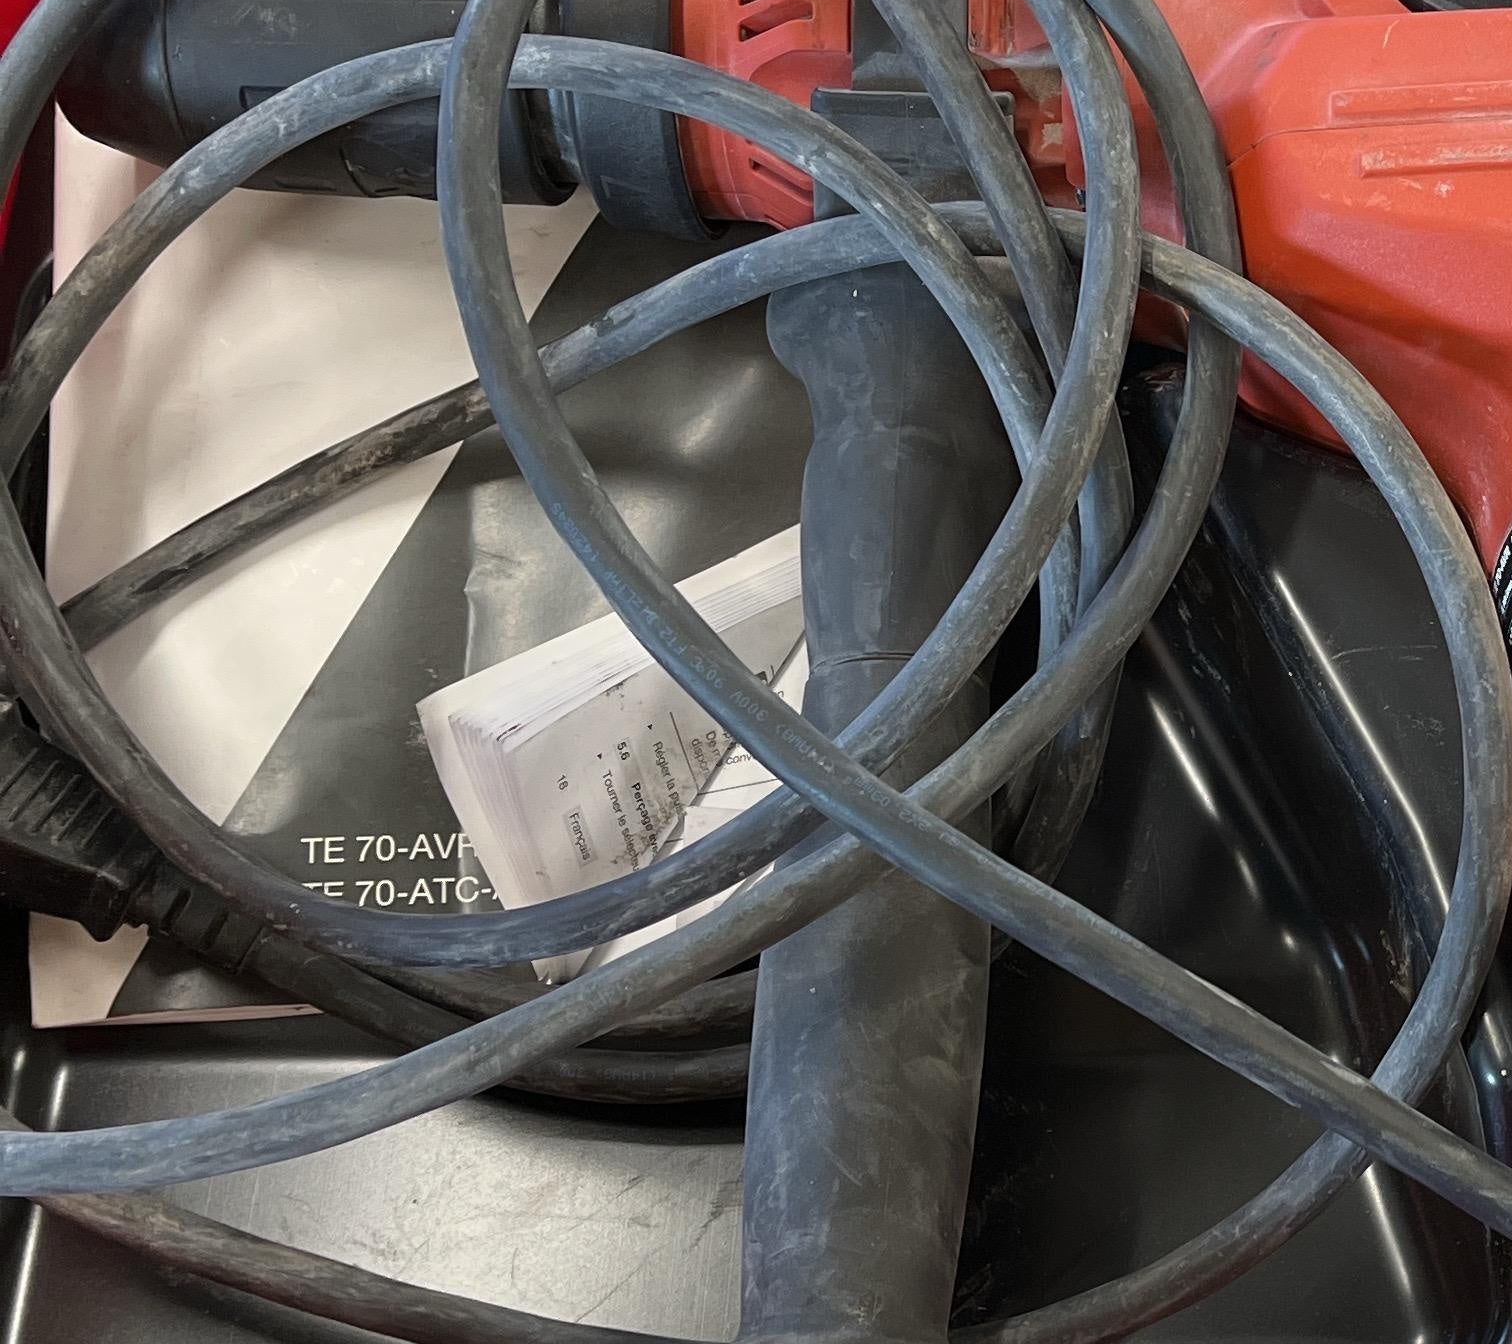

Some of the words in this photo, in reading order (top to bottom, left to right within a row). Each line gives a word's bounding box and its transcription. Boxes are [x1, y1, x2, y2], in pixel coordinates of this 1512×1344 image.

[616, 740, 631, 761] 5.6
[630, 782, 655, 832] Perçage
[652, 740, 673, 777] Régler
[665, 779, 677, 791] la
[555, 773, 569, 792] 18
[568, 811, 592, 862] Français
[601, 768, 624, 814] Tourner
[616, 814, 627, 827] le
[300, 836, 346, 864] TE
